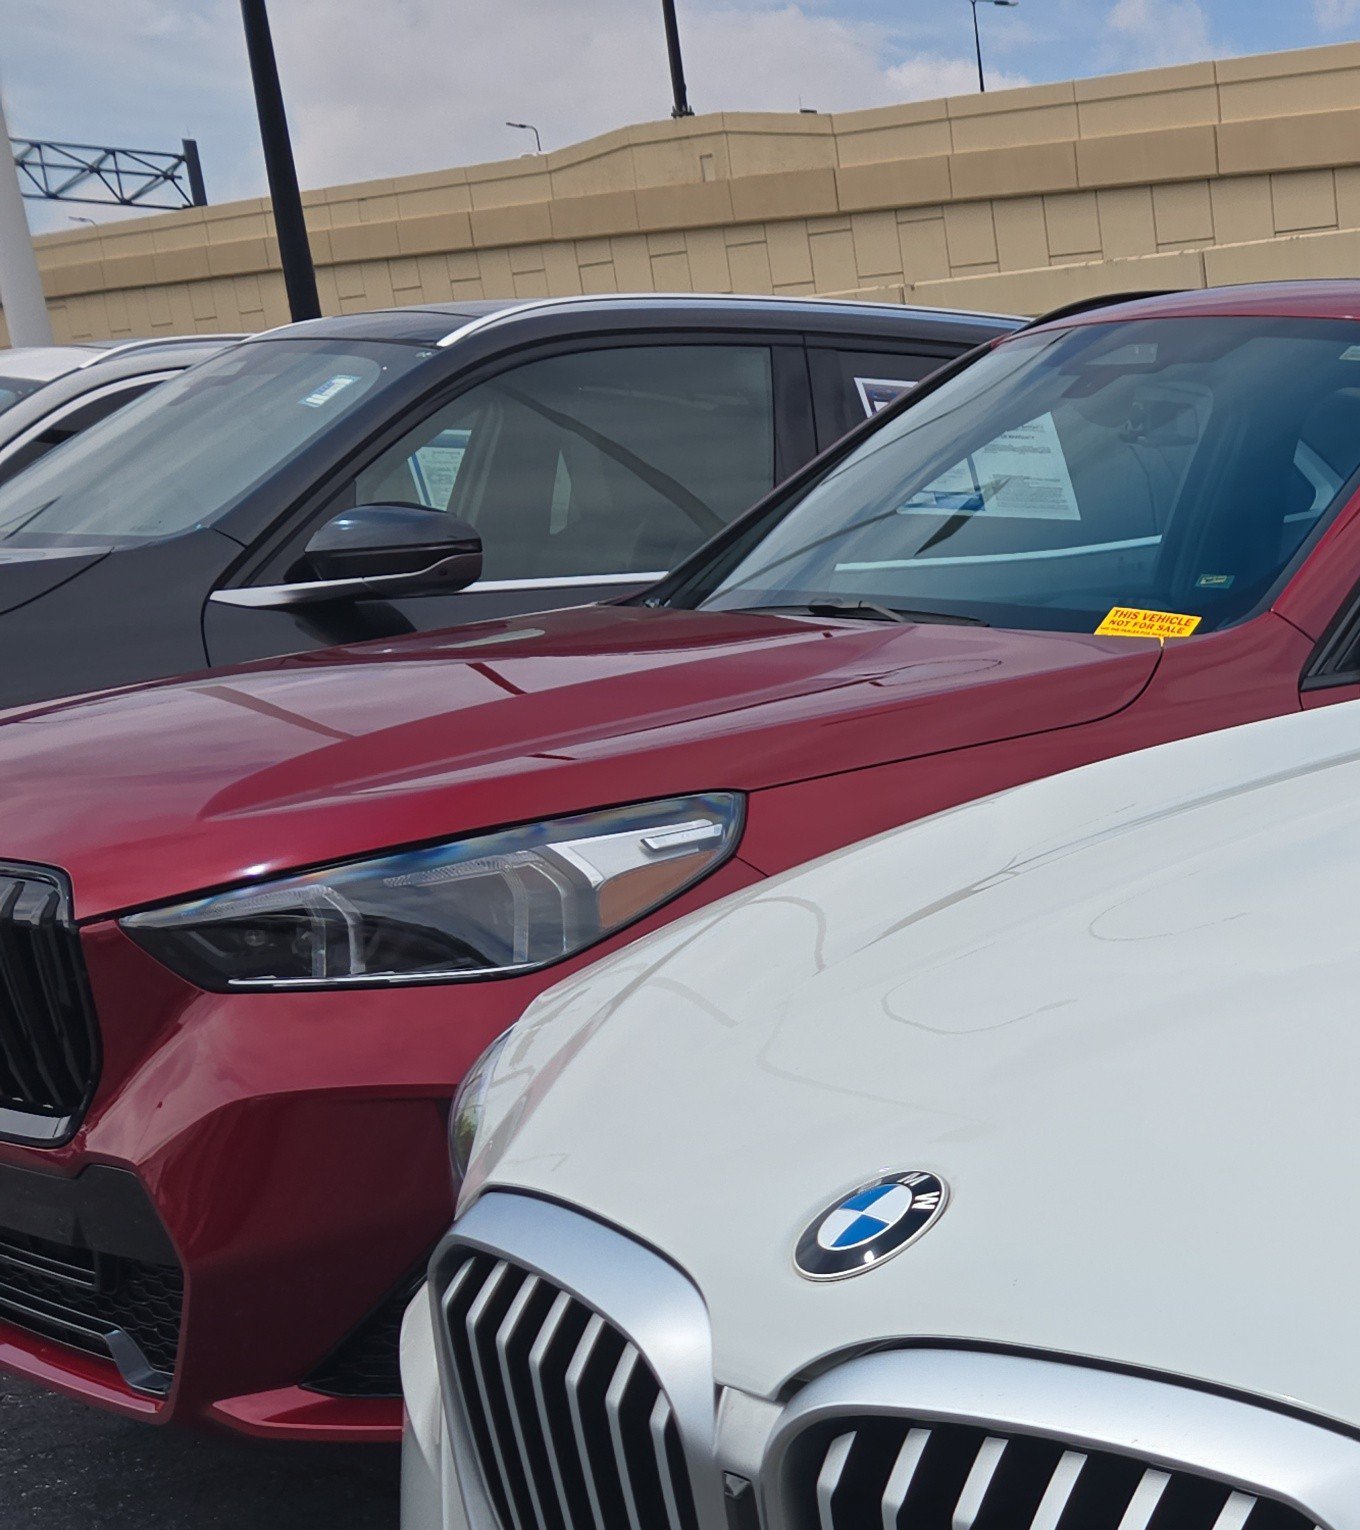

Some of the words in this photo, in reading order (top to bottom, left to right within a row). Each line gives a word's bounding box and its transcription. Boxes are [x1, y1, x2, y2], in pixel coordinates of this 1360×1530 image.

[1113, 609, 1139, 620] THIS
[1142, 613, 1194, 627] VEHICLE
[1109, 619, 1129, 627] NOT
[1132, 621, 1153, 630] FOR
[1156, 625, 1186, 634] SALE
